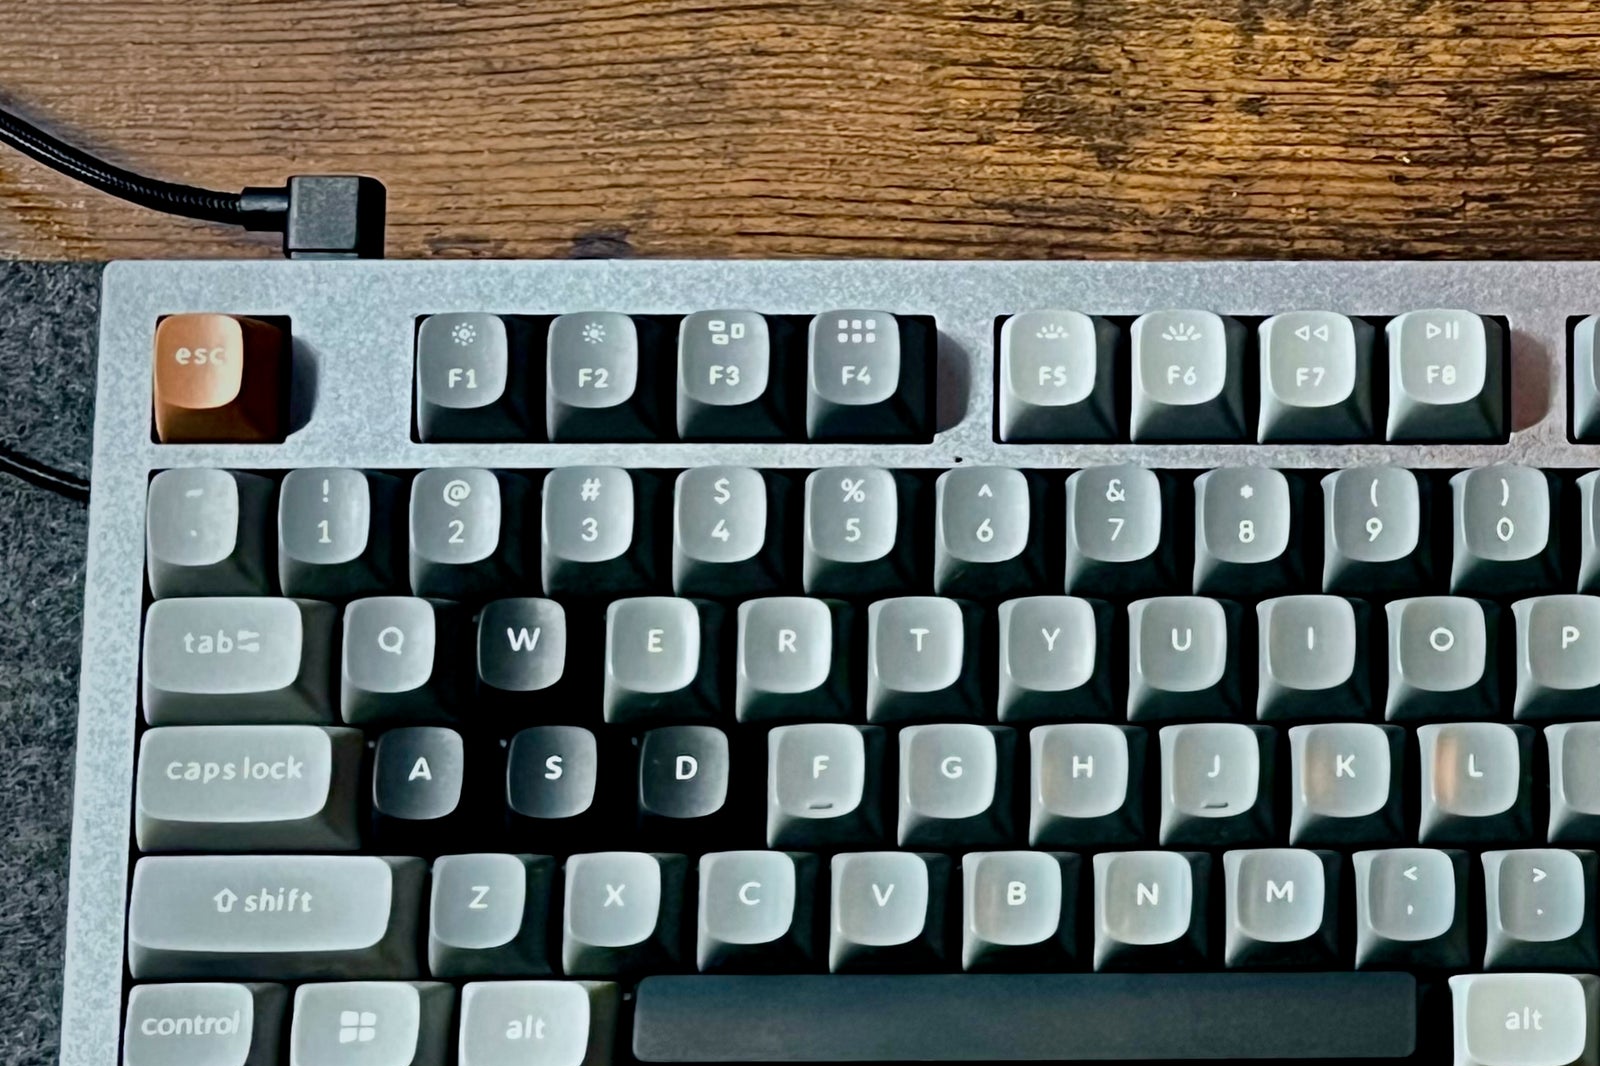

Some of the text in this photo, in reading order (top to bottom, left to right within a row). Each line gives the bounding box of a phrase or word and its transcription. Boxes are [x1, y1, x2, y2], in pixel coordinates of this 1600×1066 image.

[175, 345, 226, 366] esc
[448, 368, 478, 388] F1
[578, 368, 608, 388] F2
[708, 366, 740, 386] F3
[842, 366, 871, 385] F4
[1038, 366, 1066, 386] F5
[1167, 366, 1197, 386] F6
[1296, 366, 1326, 388] F7
[1426, 365, 1456, 385] F8
[320, 479, 330, 502] !
[442, 480, 470, 506] @
[581, 478, 601, 501] #
[714, 478, 730, 504] $
[840, 478, 866, 502] %
[978, 484, 994, 498] ^
[1106, 479, 1125, 502] &
[1370, 479, 1379, 508] (
[1500, 478, 1509, 506] )
[318, 520, 332, 542] 1
[448, 520, 464, 542] 2
[582, 518, 598, 542] 3
[711, 520, 730, 542] 4
[845, 518, 861, 542] 5
[976, 518, 994, 542] 6
[1108, 518, 1124, 542] 7
[1238, 520, 1255, 542] 8
[1366, 517, 1383, 542] 9
[1496, 516, 1514, 542] 0
[184, 630, 233, 654] tab
[378, 626, 404, 654] Q
[506, 626, 540, 652] W
[648, 628, 663, 652] E
[778, 629, 796, 652] R
[910, 628, 930, 652] T
[1042, 628, 1060, 651] Y
[1172, 628, 1192, 652] U
[1430, 627, 1454, 651] O
[1562, 626, 1580, 649] P
[166, 755, 303, 784] caps lock
[408, 757, 432, 782] A
[544, 754, 562, 780] S
[676, 756, 698, 780] D
[813, 755, 830, 778] F
[940, 756, 963, 779] G
[1072, 756, 1094, 778] H
[1208, 754, 1220, 778] J
[1336, 754, 1356, 777] K
[1468, 754, 1483, 777] L
[1403, 867, 1418, 880] <
[1532, 868, 1547, 882] >
[244, 888, 312, 913] shift
[468, 886, 490, 909] Z
[604, 884, 625, 907] X
[738, 882, 761, 905] C
[872, 884, 894, 906] V
[1006, 881, 1026, 906] B
[1136, 882, 1158, 905] N
[1266, 880, 1293, 902] M
[140, 1010, 240, 1036] control
[506, 1016, 544, 1040] alt
[1504, 1007, 1542, 1031] alt
